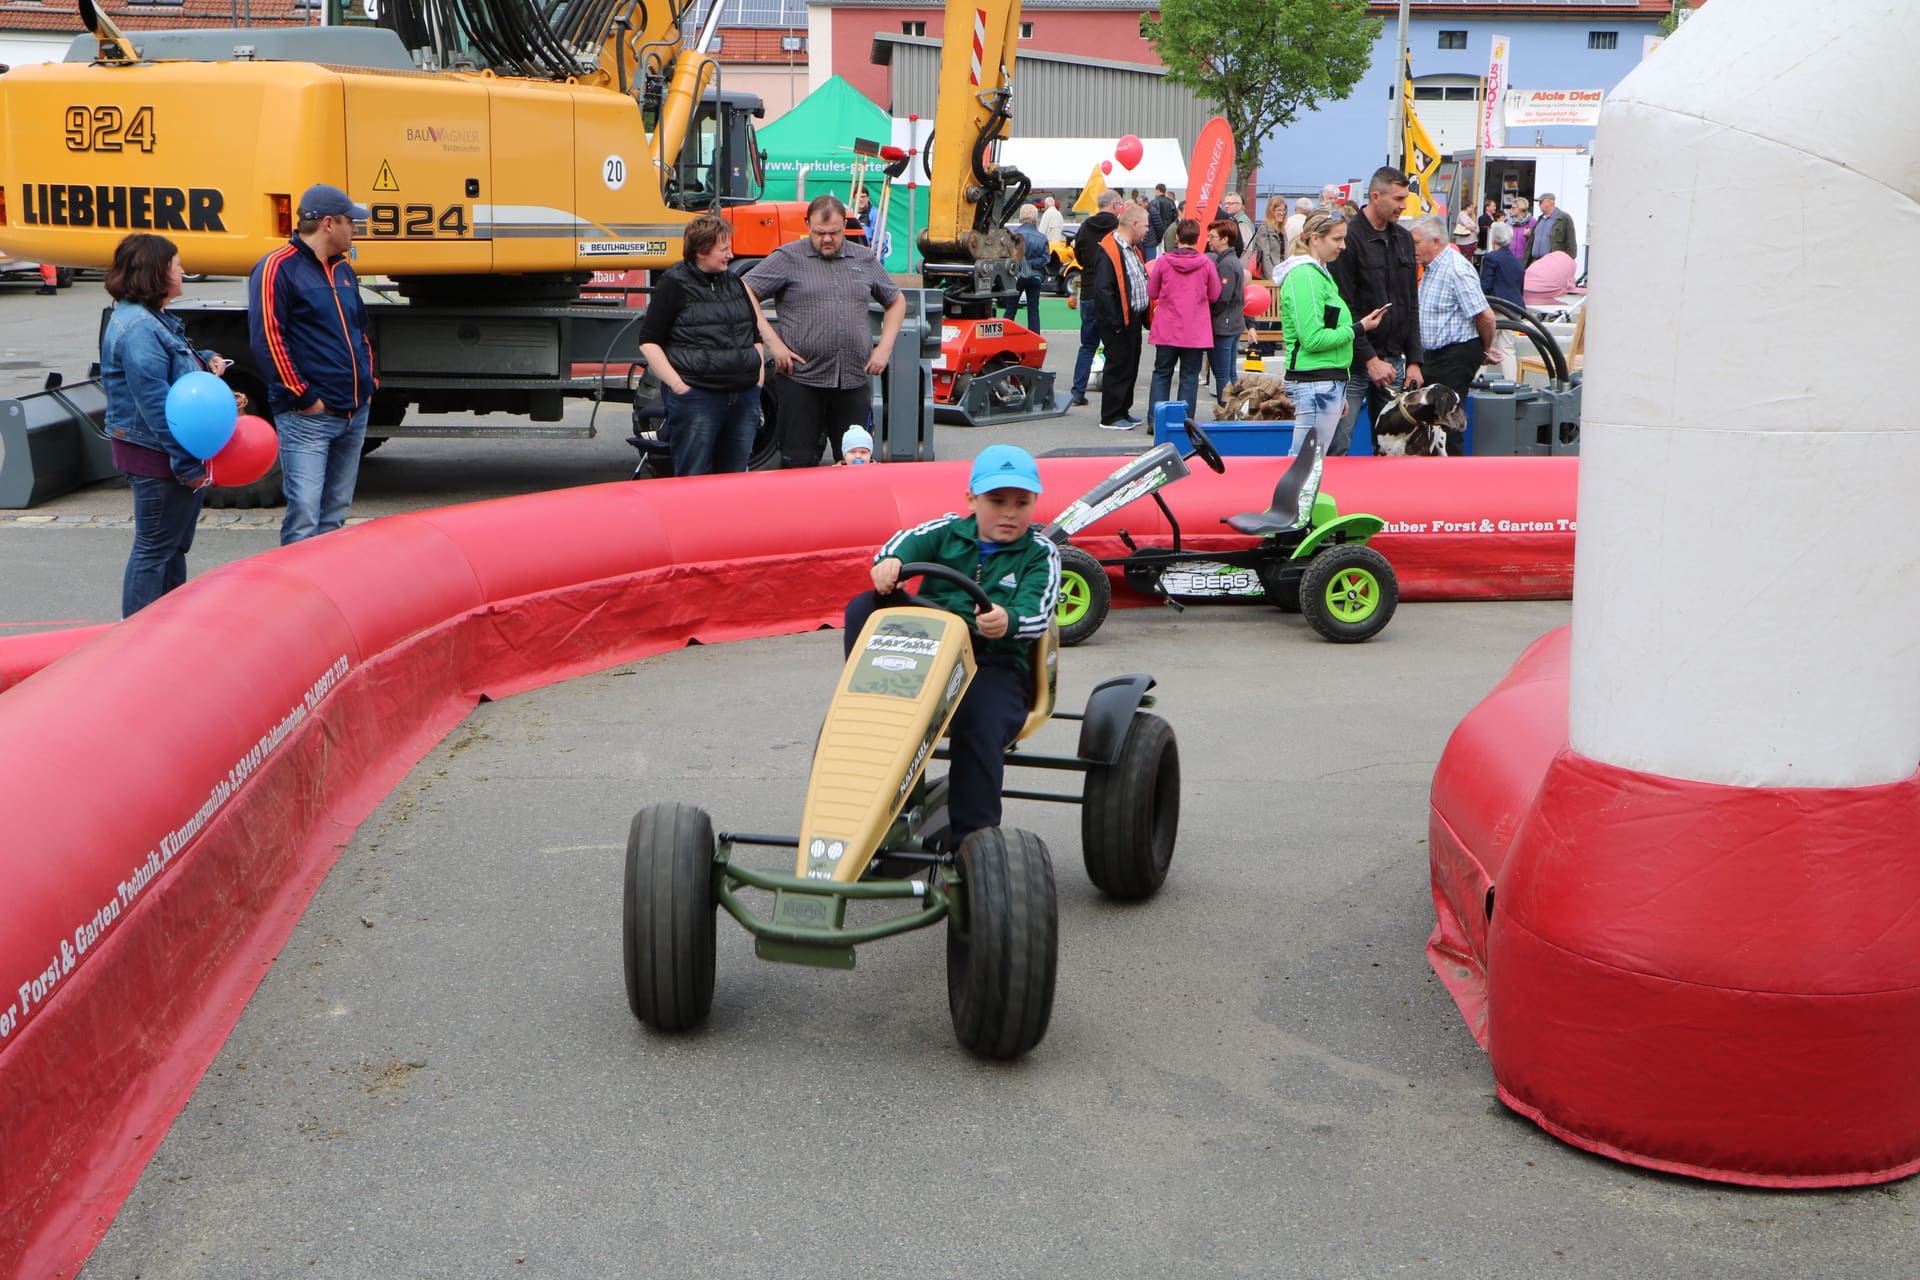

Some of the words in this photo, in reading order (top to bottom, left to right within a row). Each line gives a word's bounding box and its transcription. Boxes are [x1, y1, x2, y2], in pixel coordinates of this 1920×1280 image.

[65, 105, 157, 153] 924
[607, 160, 623, 182] 20
[22, 183, 228, 233] LIEBHERR
[370, 203, 469, 238] 924
[591, 243, 646, 252] BEUTLHAUSER
[984, 323, 1003, 333] MTS
[1432, 520, 1476, 533] Forst
[1479, 518, 1495, 533] &
[1498, 519, 1554, 532] Garten
[1192, 574, 1249, 591] BERG
[18, 956, 61, 1016] Forst
[59, 939, 76, 975] &
[75, 897, 121, 955] Garten
